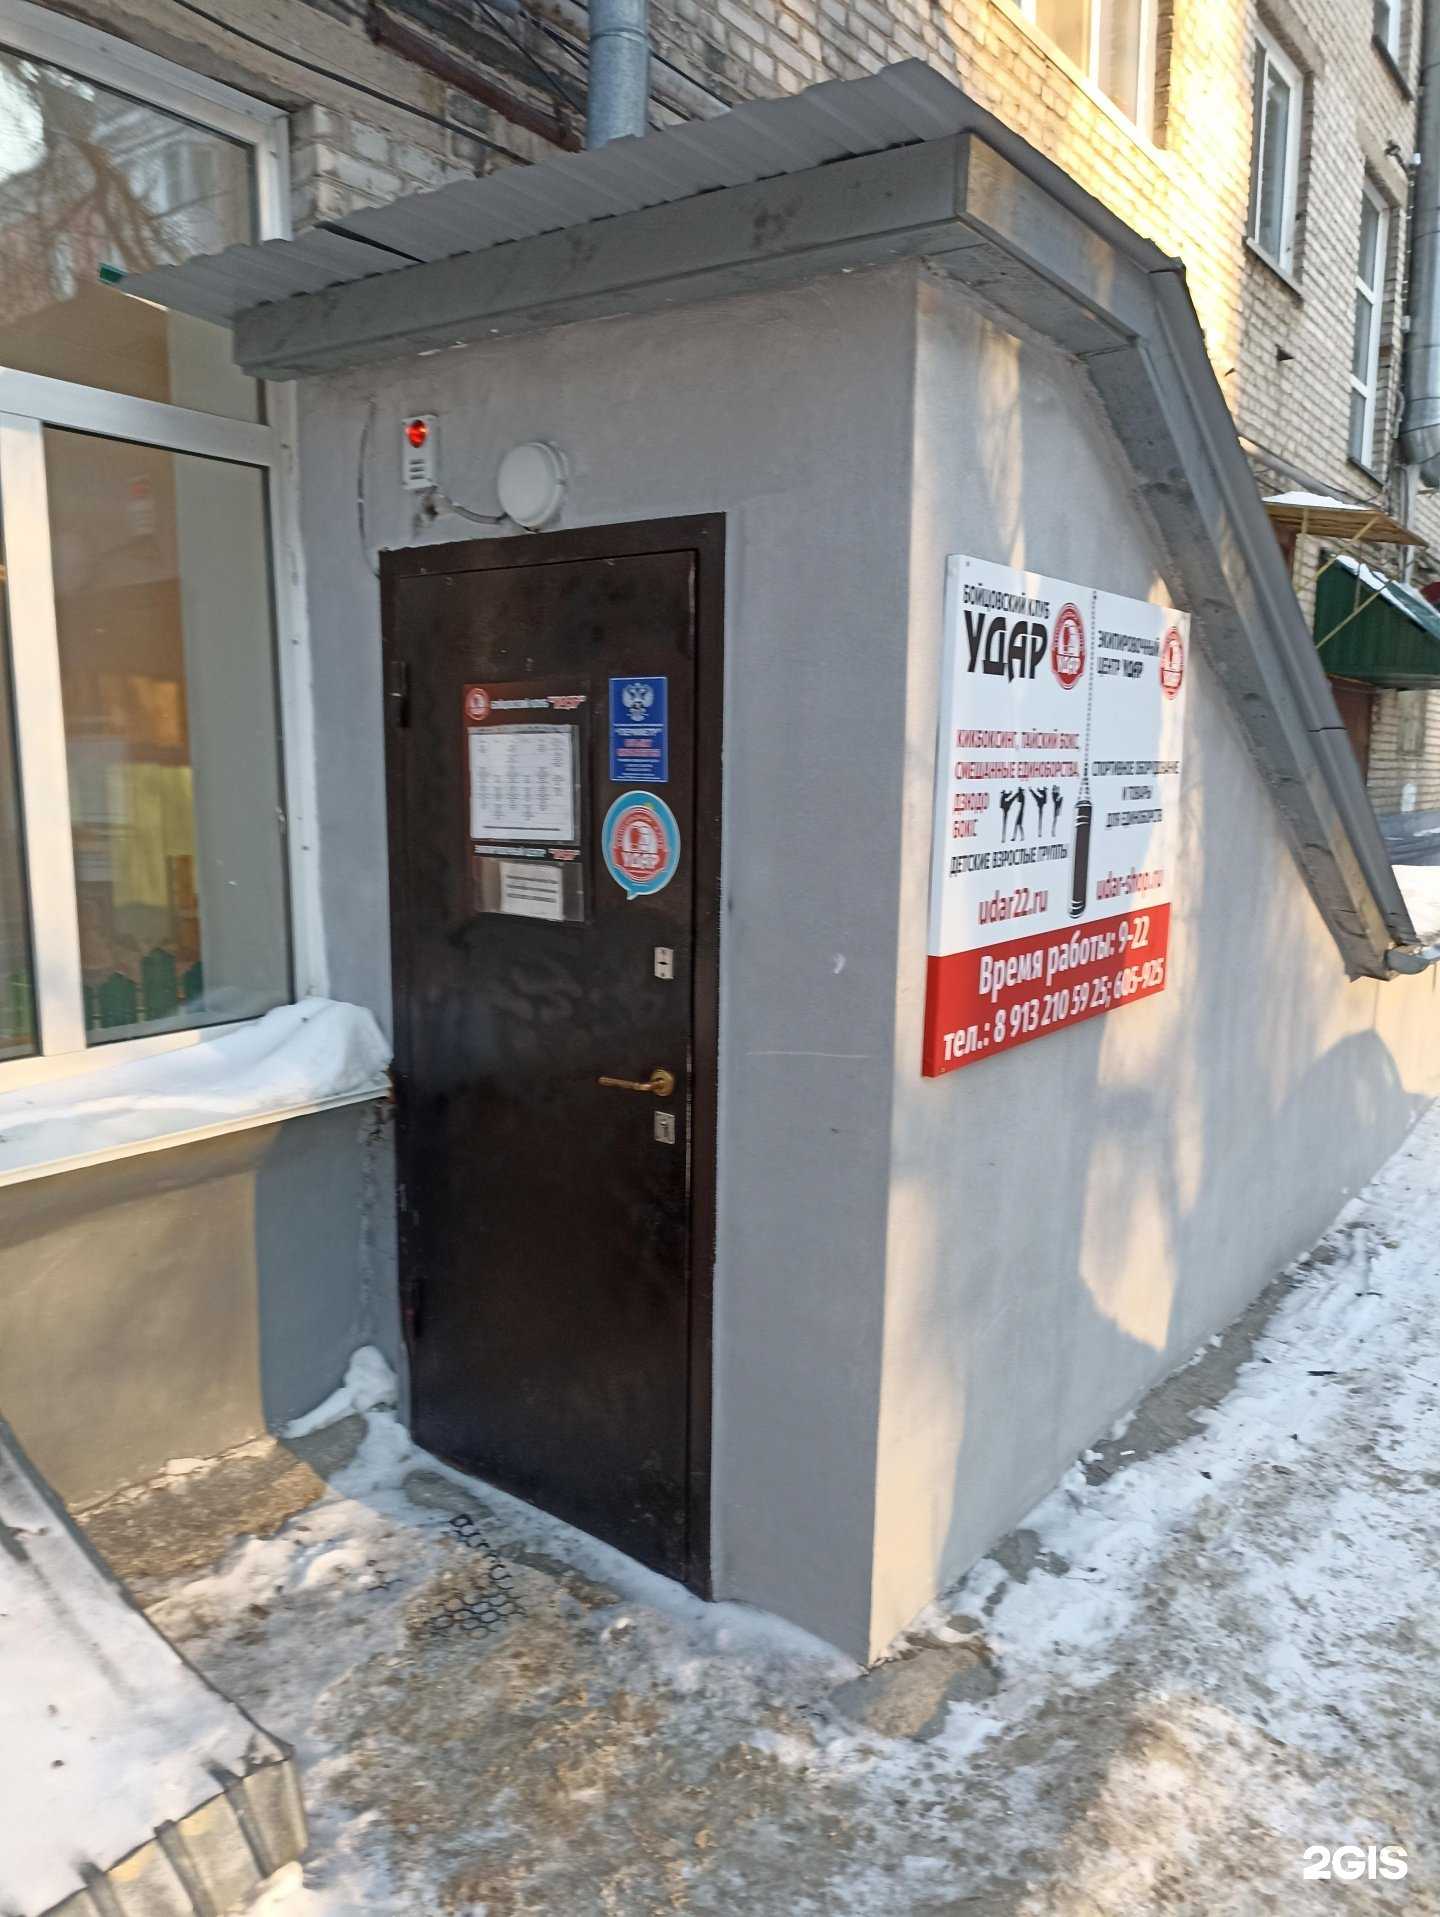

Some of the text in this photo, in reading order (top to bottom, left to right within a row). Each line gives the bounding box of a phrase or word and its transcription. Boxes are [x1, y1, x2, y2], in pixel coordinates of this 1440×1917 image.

[963, 582, 1050, 619] БОЙЦОВСКИЙ КЛУБ
[963, 610, 1048, 683] УДАР
[1022, 728, 1059, 749] ТАЙСКИЙ
[1060, 733, 1080, 749] БОКС
[955, 761, 1015, 780] СМЕШАННЫЕ
[953, 792, 990, 814] ДЗЮДО
[952, 819, 979, 839] БОКС
[949, 843, 1069, 878] ДЕТСКИЕ ВЗРОСЛЫЕ ГРУППЫ
[1096, 866, 1165, 900] udar-shop.ru
[978, 888, 1049, 925] udar22.ru
[978, 915, 1150, 1003] Время работы: 9-22
[943, 957, 1165, 1061] тел.: 8 913 210 59 25; 605-925
